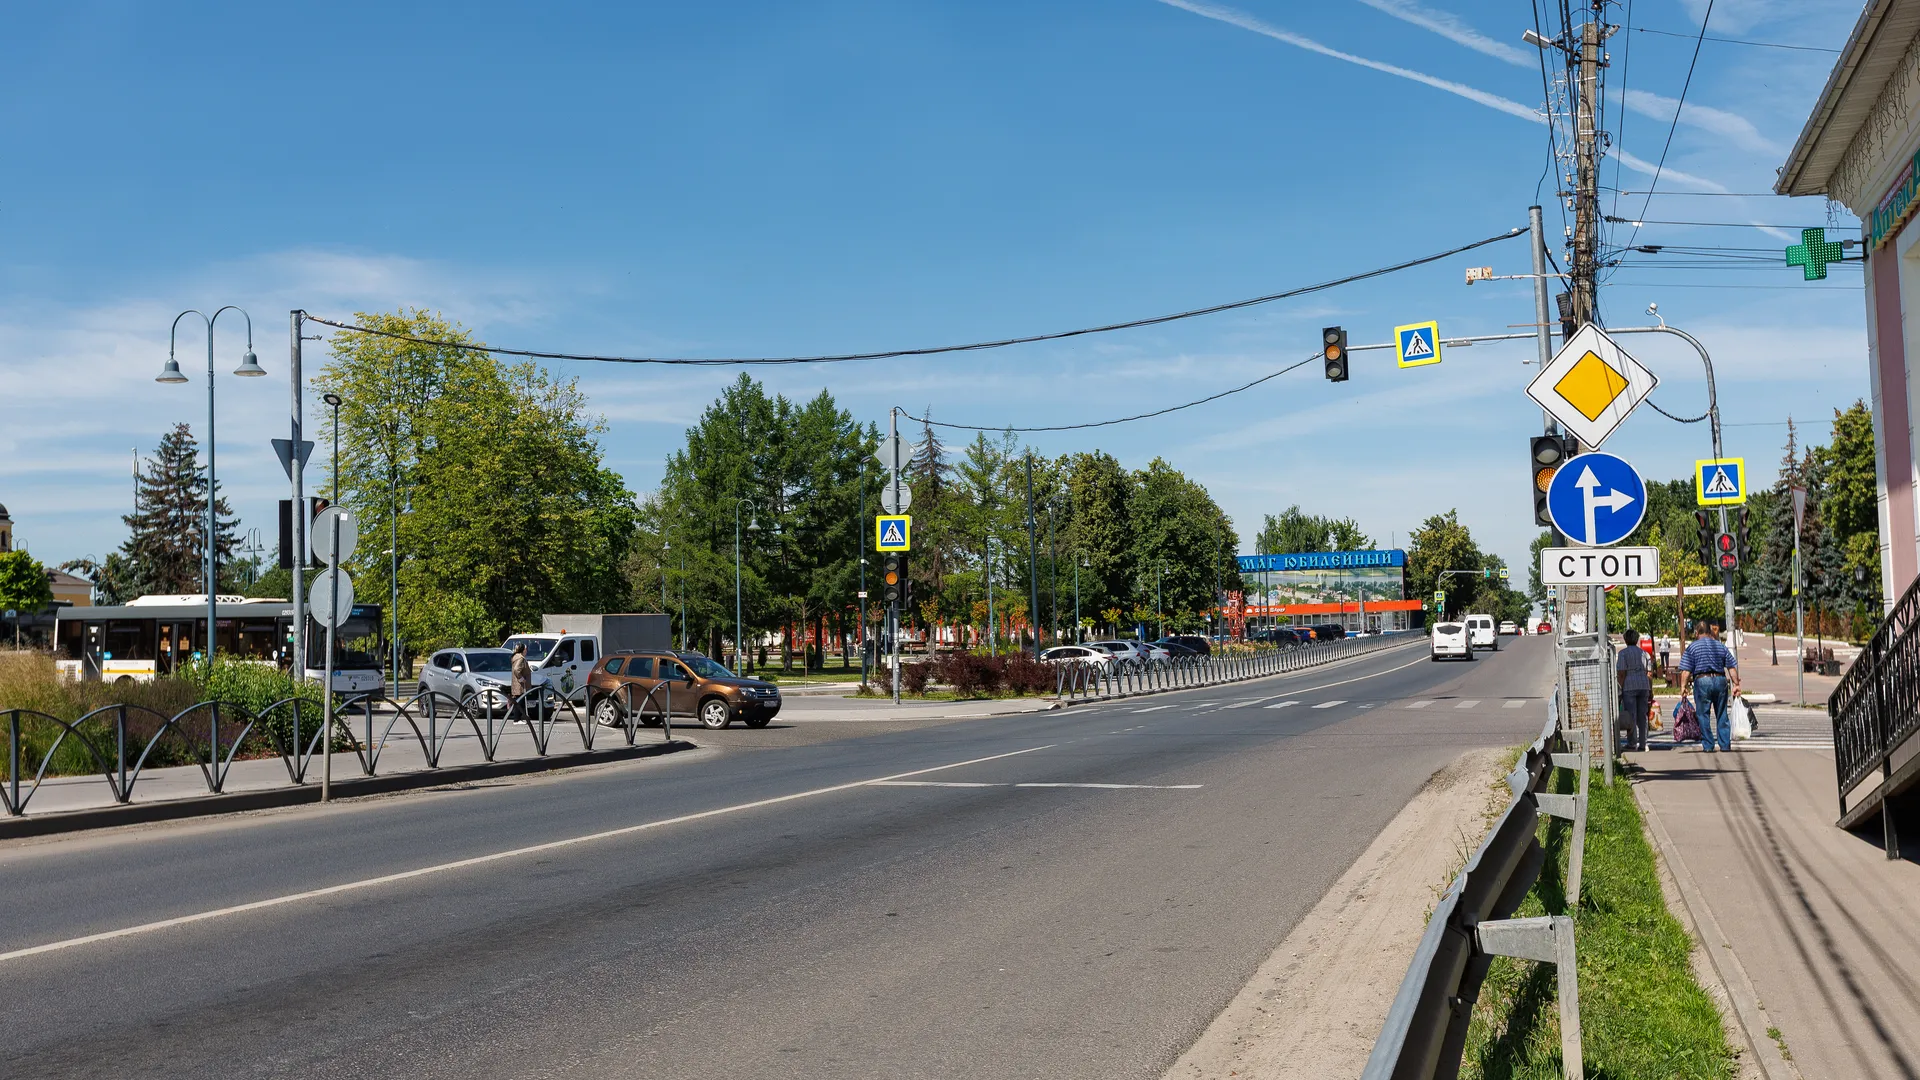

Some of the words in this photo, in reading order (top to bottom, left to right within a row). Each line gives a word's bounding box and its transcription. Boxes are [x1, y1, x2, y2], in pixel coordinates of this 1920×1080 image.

[1238, 557, 1276, 570] МАГ
[1284, 551, 1392, 568] ЮБИЛЕЙНЫЙ
[1558, 555, 1642, 577] СТОП
[1722, 555, 1735, 567] 24
